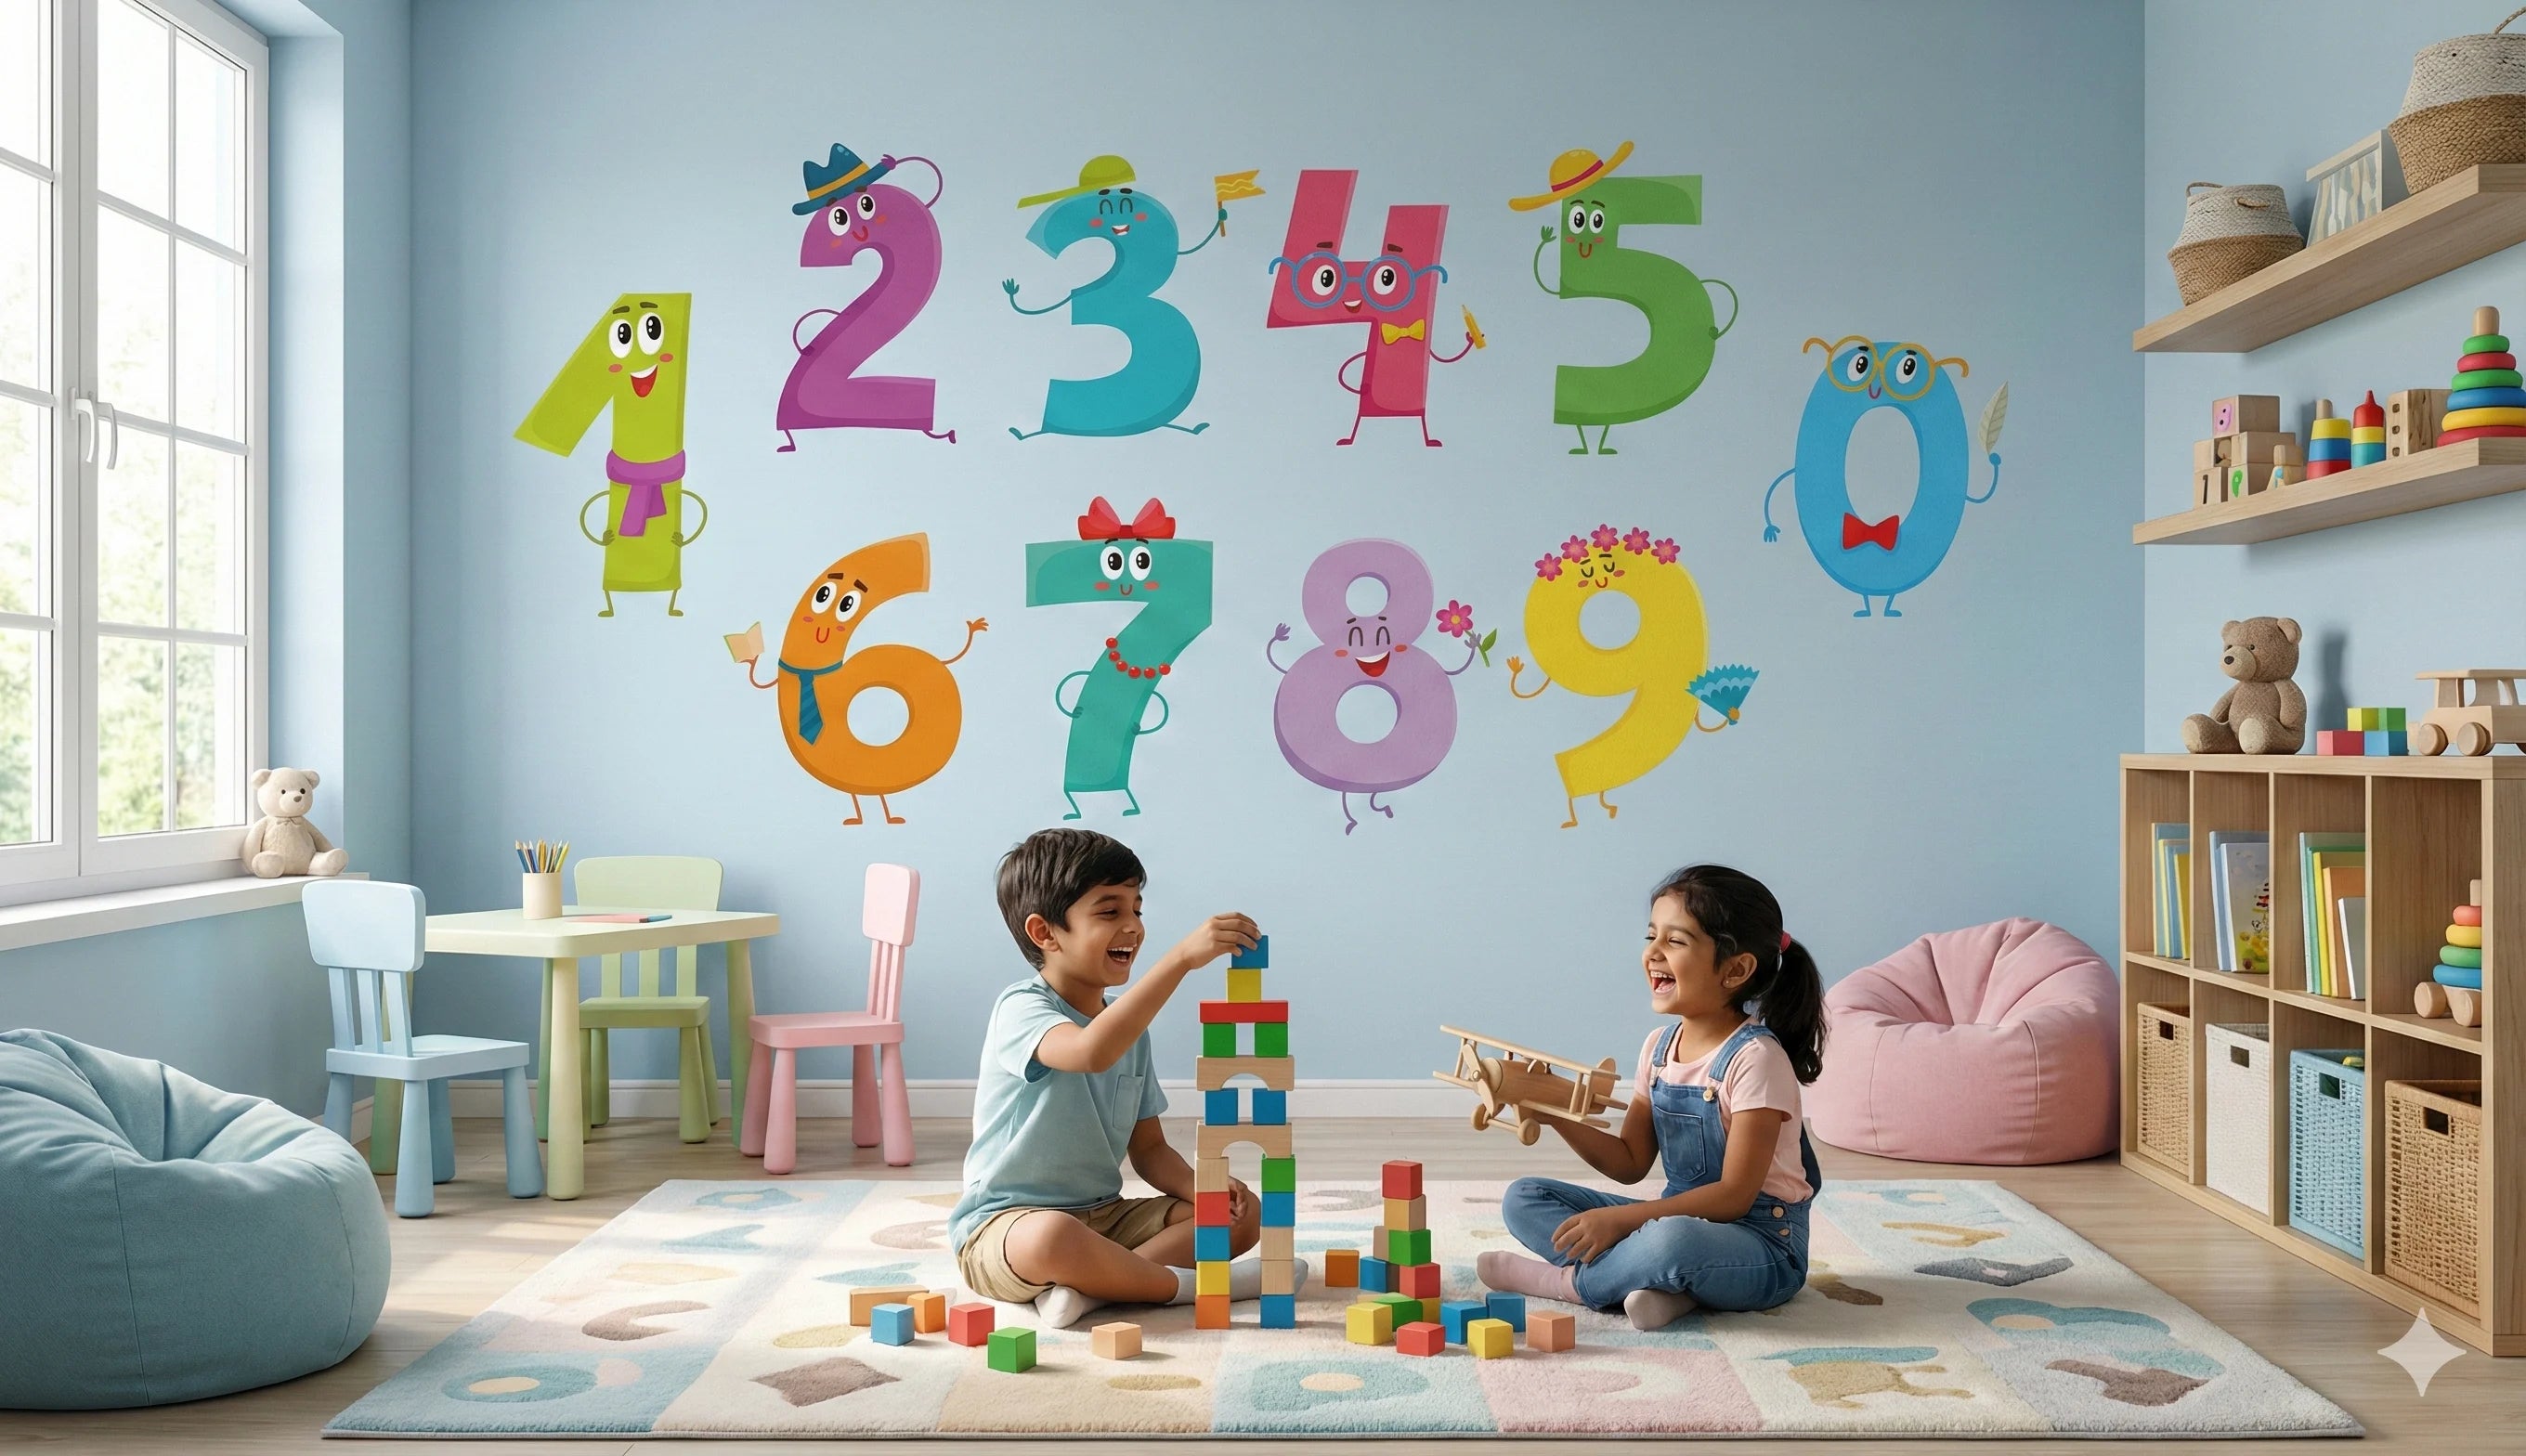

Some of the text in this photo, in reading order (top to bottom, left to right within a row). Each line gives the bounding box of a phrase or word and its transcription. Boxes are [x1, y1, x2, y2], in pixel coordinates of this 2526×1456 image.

[776, 169, 1716, 437] 2 3 4 5
[513, 292, 692, 592] 1
[1794, 341, 1969, 596] 0
[777, 532, 1709, 799] 6 7 8 9
